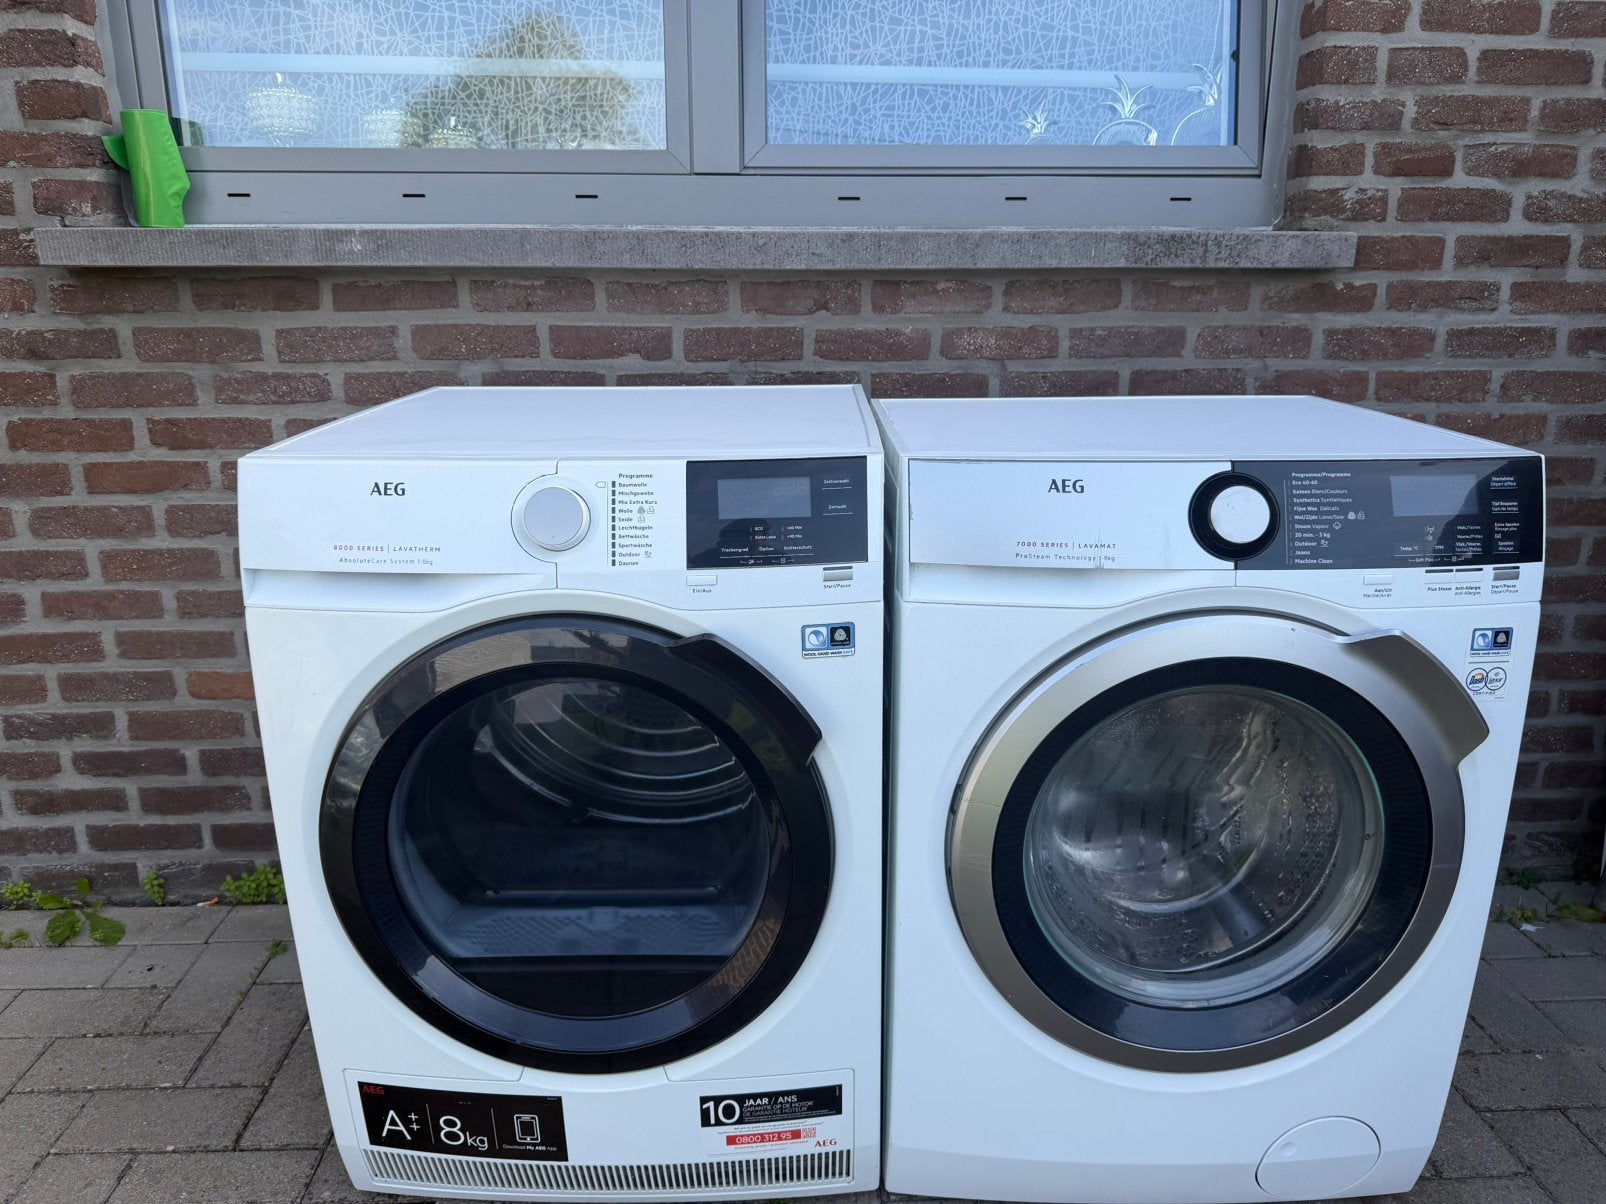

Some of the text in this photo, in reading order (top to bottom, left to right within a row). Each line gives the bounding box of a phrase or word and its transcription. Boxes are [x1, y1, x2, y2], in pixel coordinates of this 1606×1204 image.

[370, 481, 406, 496] AEG
[1048, 478, 1084, 494] AEG
[362, 1084, 384, 1095] AEG
[744, 1097, 769, 1107] JAAR
[778, 1095, 797, 1104] ANS
[702, 1099, 741, 1125] 10
[736, 1136, 762, 1144] 0800
[814, 1138, 837, 1147] AEG
